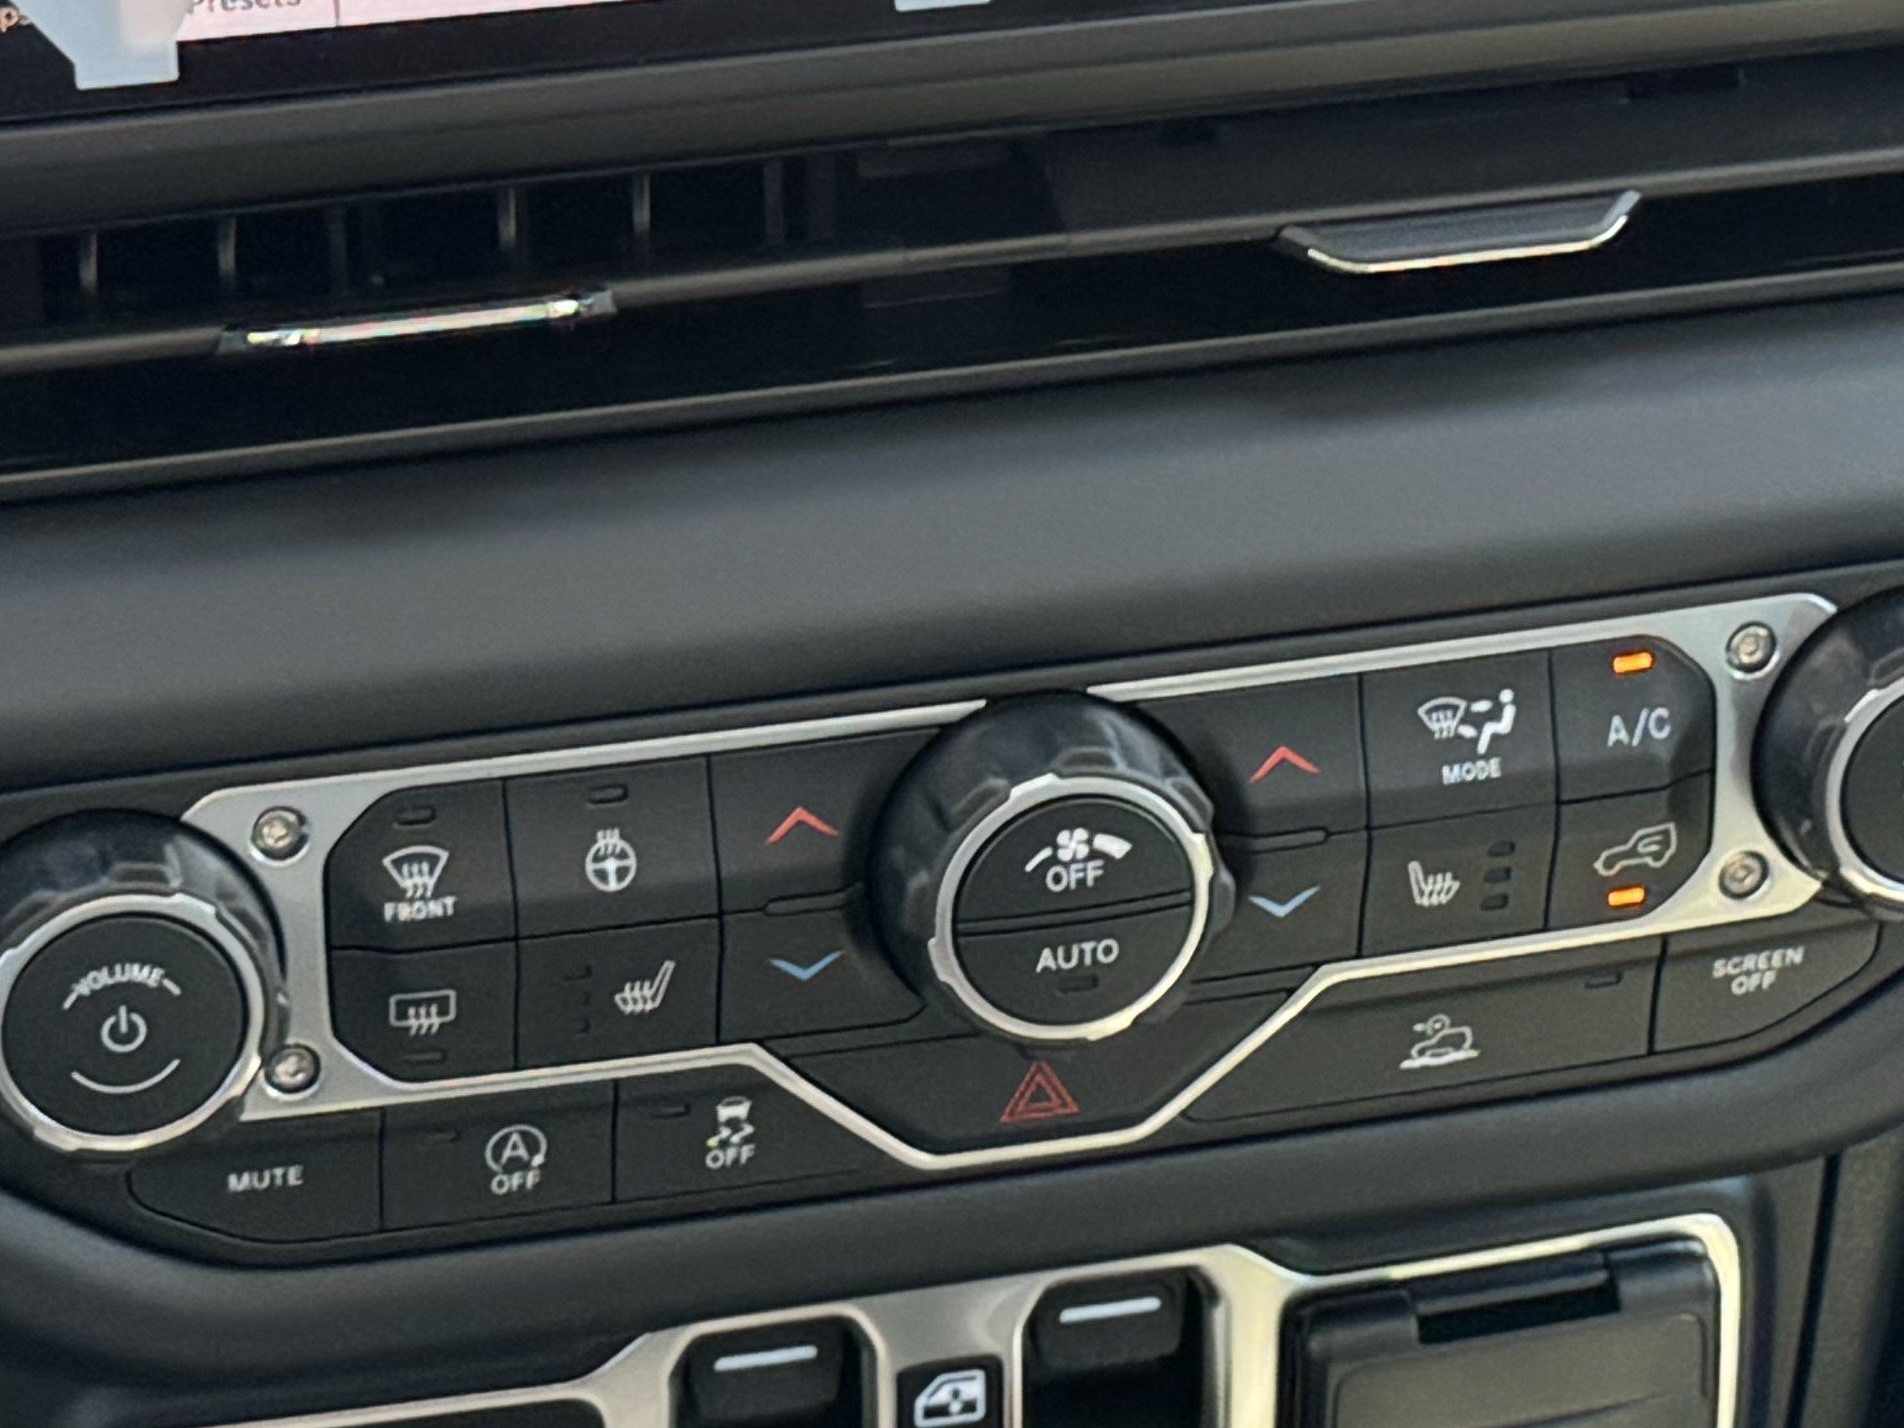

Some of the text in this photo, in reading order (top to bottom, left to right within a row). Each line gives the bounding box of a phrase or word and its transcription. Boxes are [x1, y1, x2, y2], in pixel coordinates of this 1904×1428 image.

[1608, 707, 1672, 748] A/C
[1442, 758, 1502, 785] MODE
[1046, 859, 1105, 893] OFF
[383, 897, 456, 923] FRONT
[1036, 938, 1119, 972] AUTO
[1713, 947, 1804, 979] SCREEN
[71, 963, 165, 996] VOLUME
[1732, 970, 1774, 995] OFF
[706, 1144, 755, 1169] OFF
[228, 1165, 304, 1193] MUTE
[491, 1171, 541, 1194] OFF
